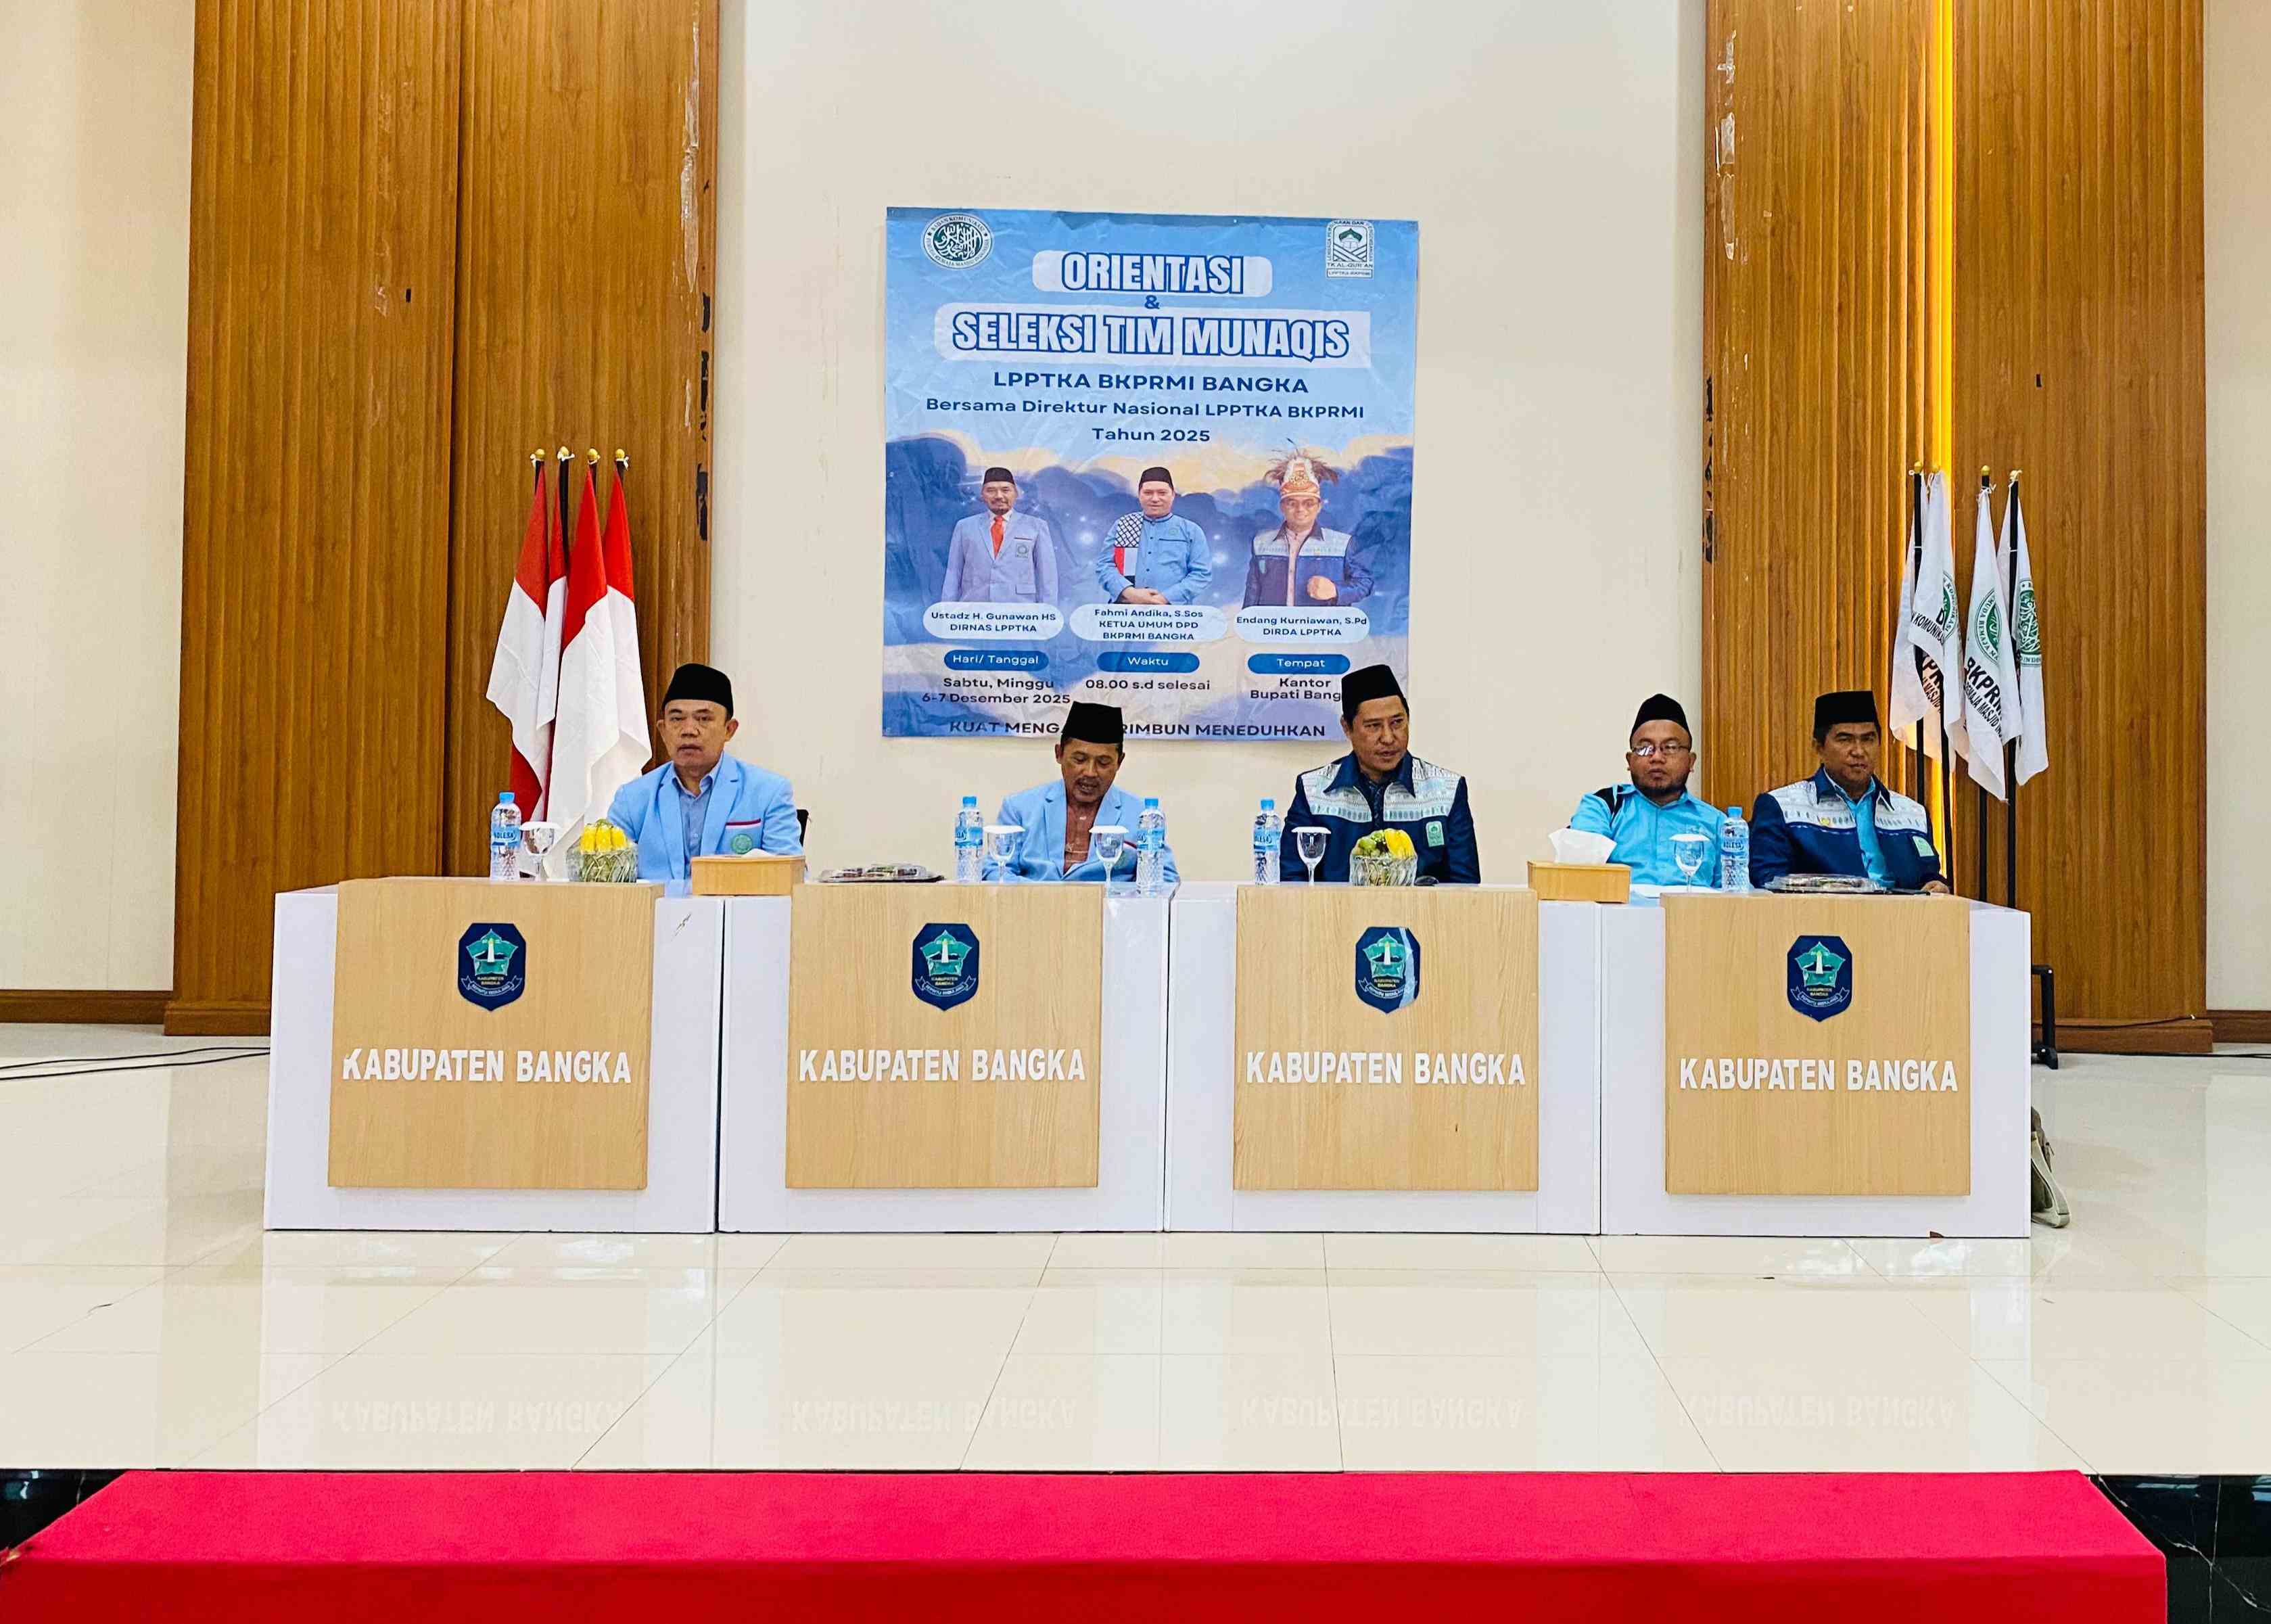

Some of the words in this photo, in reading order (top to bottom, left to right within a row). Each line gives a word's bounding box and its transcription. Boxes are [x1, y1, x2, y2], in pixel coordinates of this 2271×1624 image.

[1061, 252, 1244, 294] ORIENTASI
[1144, 295, 1160, 309] &
[952, 312, 1096, 353] SELEKSI
[1102, 315, 1174, 354] TIM
[1182, 316, 1349, 363] MUNAQIS
[994, 371, 1090, 388] LPPTKA
[1098, 374, 1194, 390] BKPRMI
[1202, 376, 1309, 393] BANGKA
[927, 398, 1016, 411] Bersama
[1023, 399, 1107, 414] Direktur
[1113, 402, 1198, 415] Nasional
[1206, 404, 1282, 417] LPPTKA
[1288, 406, 1363, 418] BKPRMI
[1092, 428, 1155, 440] Tahun
[1161, 429, 1210, 442] 2025
[931, 611, 969, 620] Ustadz
[986, 612, 1039, 620] Gunawan
[1131, 609, 1171, 618] Andika,
[1237, 616, 1277, 626] Endang
[1280, 617, 1342, 625] Kurniawan,
[1344, 617, 1367, 625] S.Pd
[1913, 613, 1944, 645] KOMUNIKA
[1148, 632, 1194, 641] BANGKA
[953, 654, 985, 664] Hari/
[988, 655, 1039, 666] Tanggal
[1127, 657, 1169, 666] Waktu
[1277, 658, 1326, 669] Tempat
[943, 678, 993, 689] Sabtu,
[998, 678, 1054, 690] Minggu
[1085, 679, 1128, 689] 08.00
[1133, 680, 1154, 689] s.d
[1158, 680, 1210, 690] selesai
[1280, 678, 1331, 688] Kantor
[922, 693, 946, 702] 6-7
[950, 693, 1027, 703] Desember
[1033, 694, 1071, 703] 2025
[1251, 689, 1299, 701] Bupati
[1304, 690, 1340, 701] Bang
[1977, 701, 1999, 727] MASJID
[950, 722, 1000, 733] KUAT
[1006, 722, 1062, 733] MENG
[1123, 724, 1189, 735] RIMBUN
[1196, 724, 1325, 737] MENEDUHKAN
[343, 1048, 504, 1082] KABUPATEN
[516, 1050, 632, 1084] BANGKA
[799, 1049, 960, 1082] KABUPATEN
[972, 1048, 1085, 1081] BANGKA
[1246, 1052, 1402, 1084] KABUPATEN
[1415, 1052, 1526, 1085] BANGKA
[1680, 1059, 1834, 1091] KABUPATEN
[1848, 1060, 1957, 1092] BANGKA
